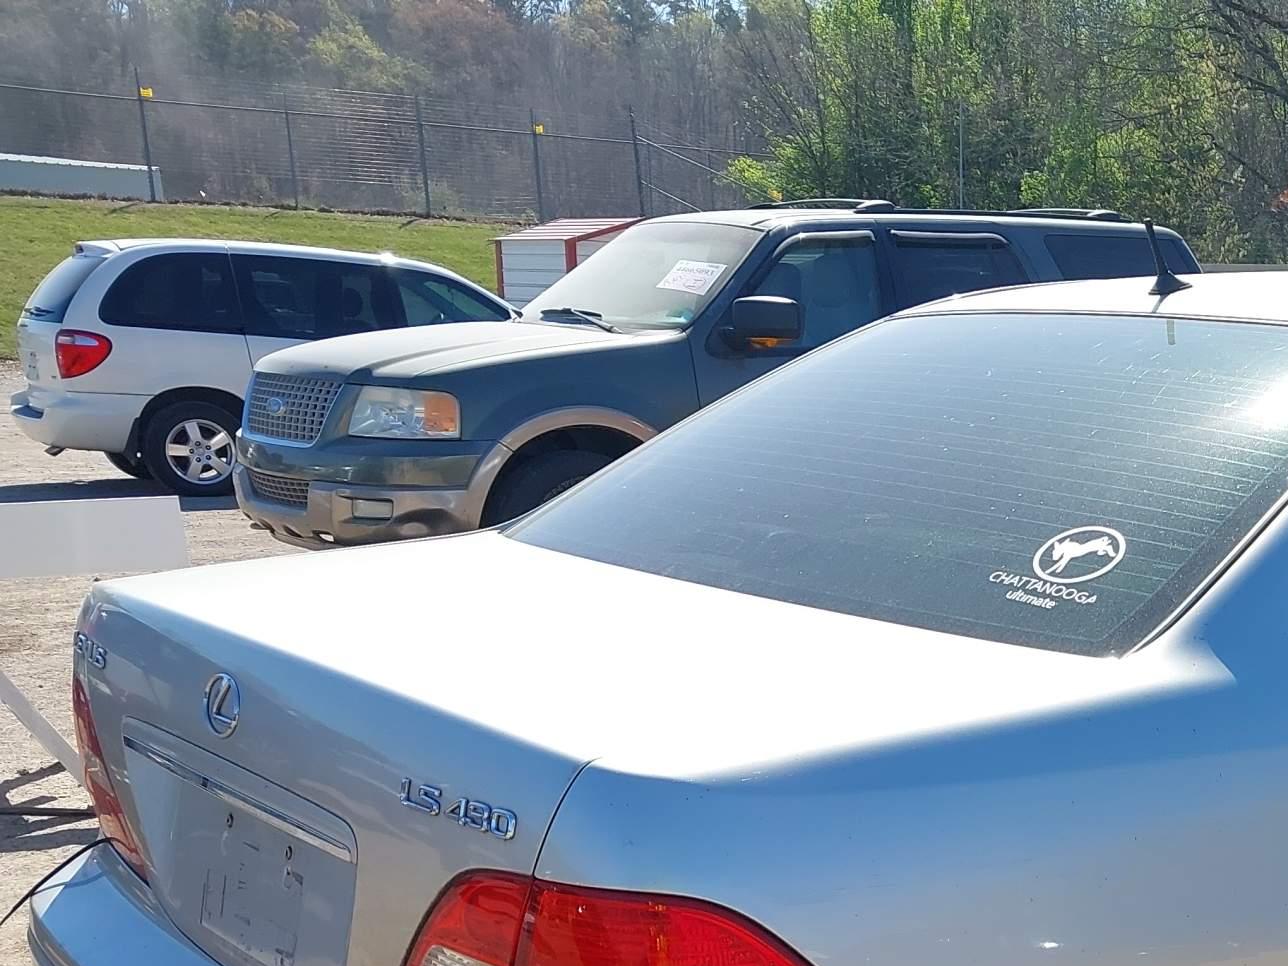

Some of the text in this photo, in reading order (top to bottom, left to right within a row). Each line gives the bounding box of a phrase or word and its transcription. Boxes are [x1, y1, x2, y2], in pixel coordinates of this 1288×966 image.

[988, 570, 1098, 605] CHATTANOOGA
[1004, 588, 1057, 610] ultimate
[399, 776, 518, 841] LS 430
